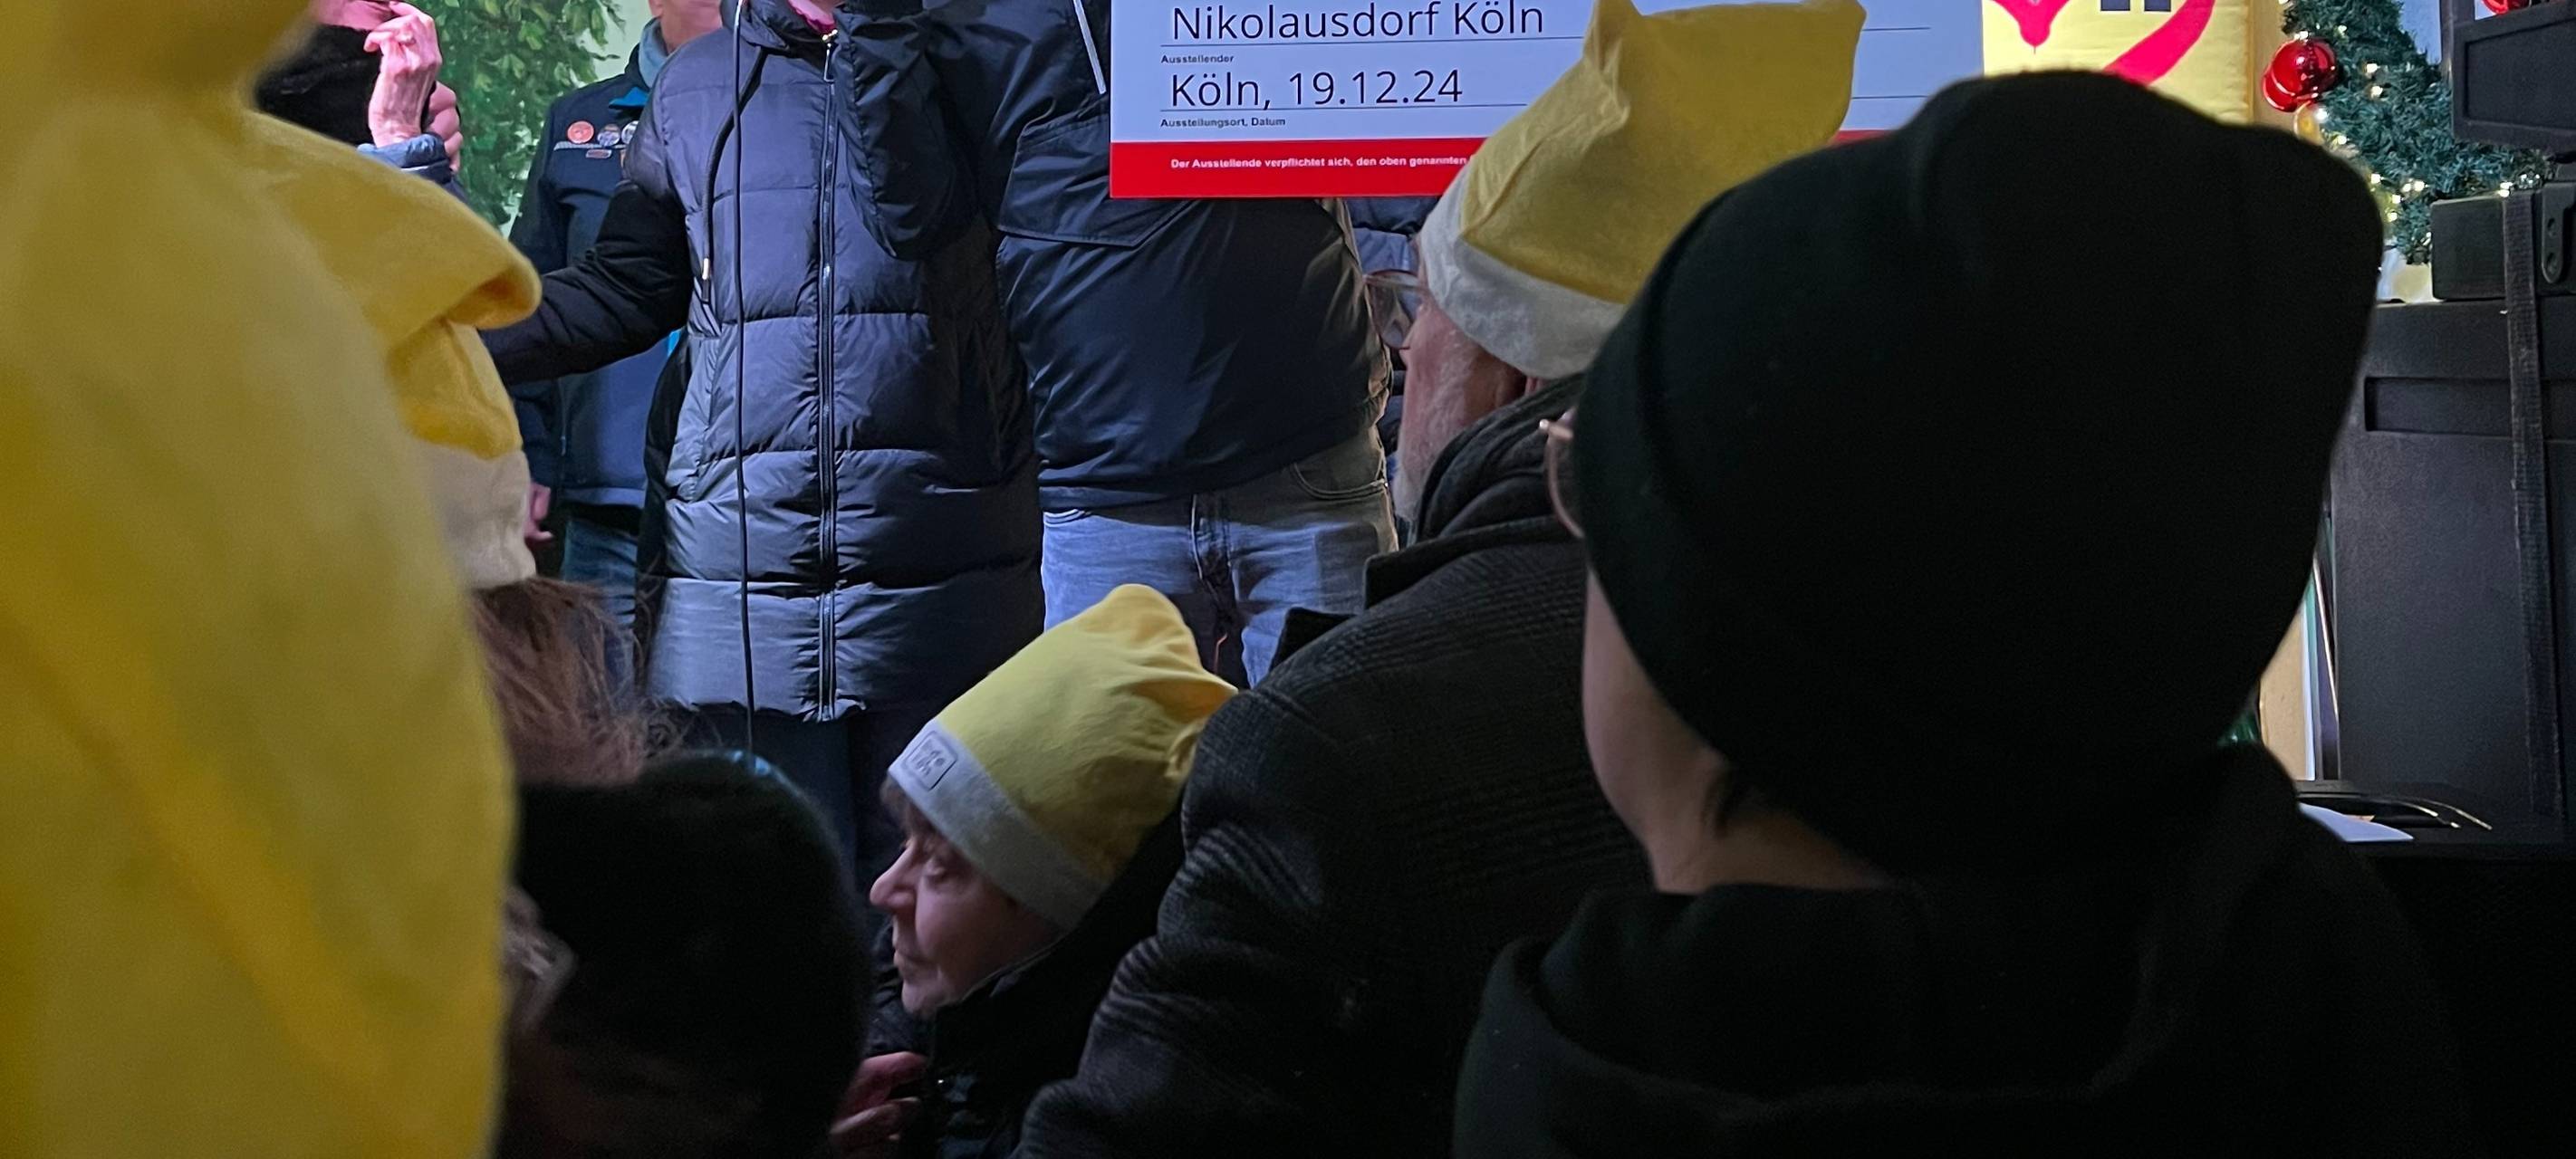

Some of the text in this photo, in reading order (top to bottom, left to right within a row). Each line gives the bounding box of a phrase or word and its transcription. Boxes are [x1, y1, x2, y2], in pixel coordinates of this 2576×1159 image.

[1174, 0, 1543, 39] Nikolausdorf Köln
[1160, 54, 1235, 63] Ausstellender
[1172, 70, 1463, 110] Köln, 19.12.24
[1160, 117, 1286, 129] Ausstellungsort, Datum
[1170, 158, 1189, 168] Der
[1191, 158, 1262, 168] Ausstellende
[1264, 158, 1325, 169] verpflichtet
[1327, 158, 1353, 167] sich,
[1356, 157, 1377, 167] den
[1379, 157, 1407, 166] oben
[1409, 157, 1467, 168] genannten
